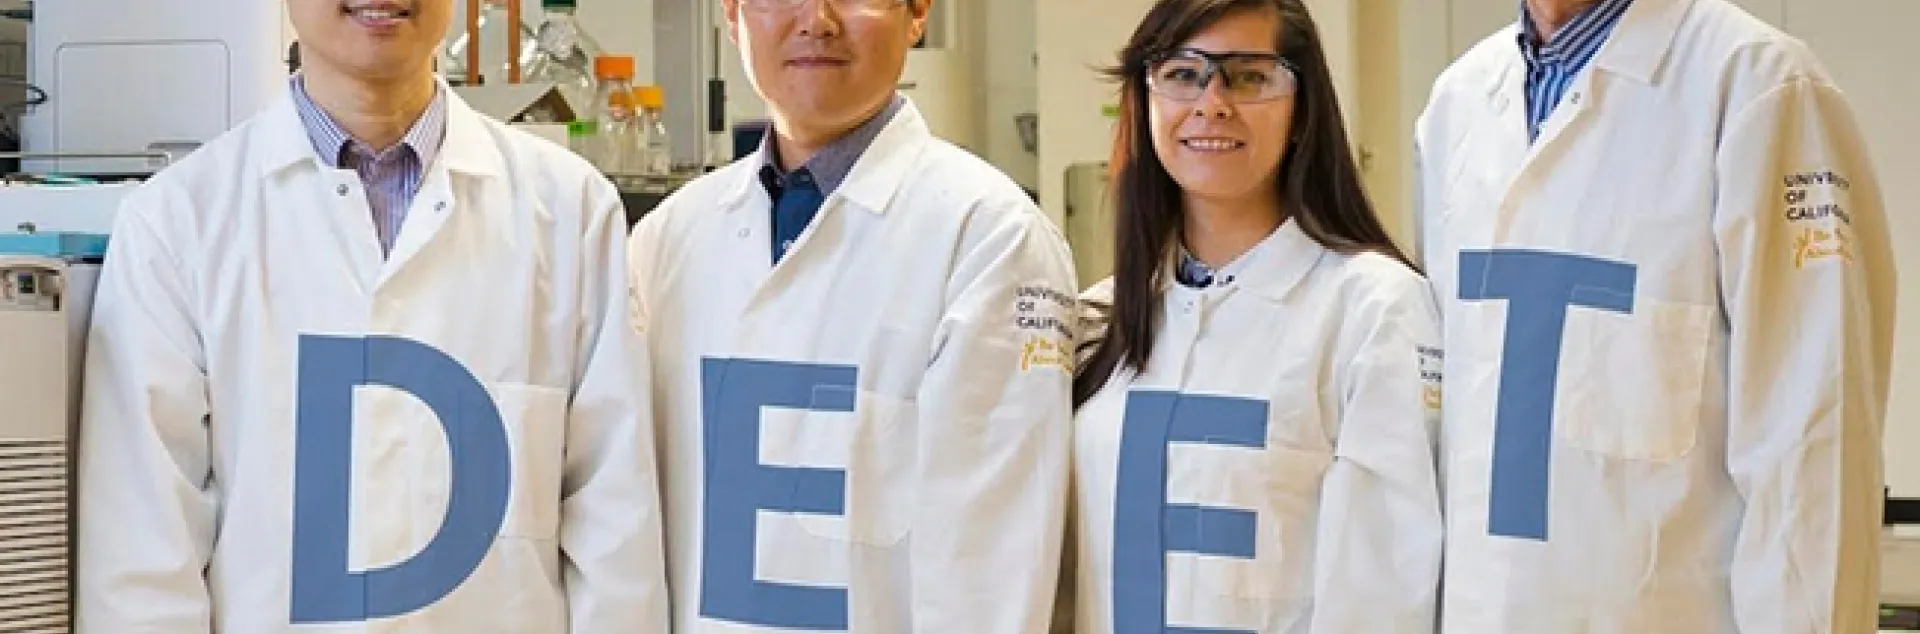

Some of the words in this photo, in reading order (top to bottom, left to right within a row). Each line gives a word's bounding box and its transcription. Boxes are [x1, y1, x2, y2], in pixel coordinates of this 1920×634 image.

[1018, 301, 1035, 312] OF
[1784, 190, 1805, 204] OF
[290, 334, 511, 624] D
[698, 356, 858, 631] E
[1112, 390, 1268, 634] E
[1457, 249, 1637, 541] T
